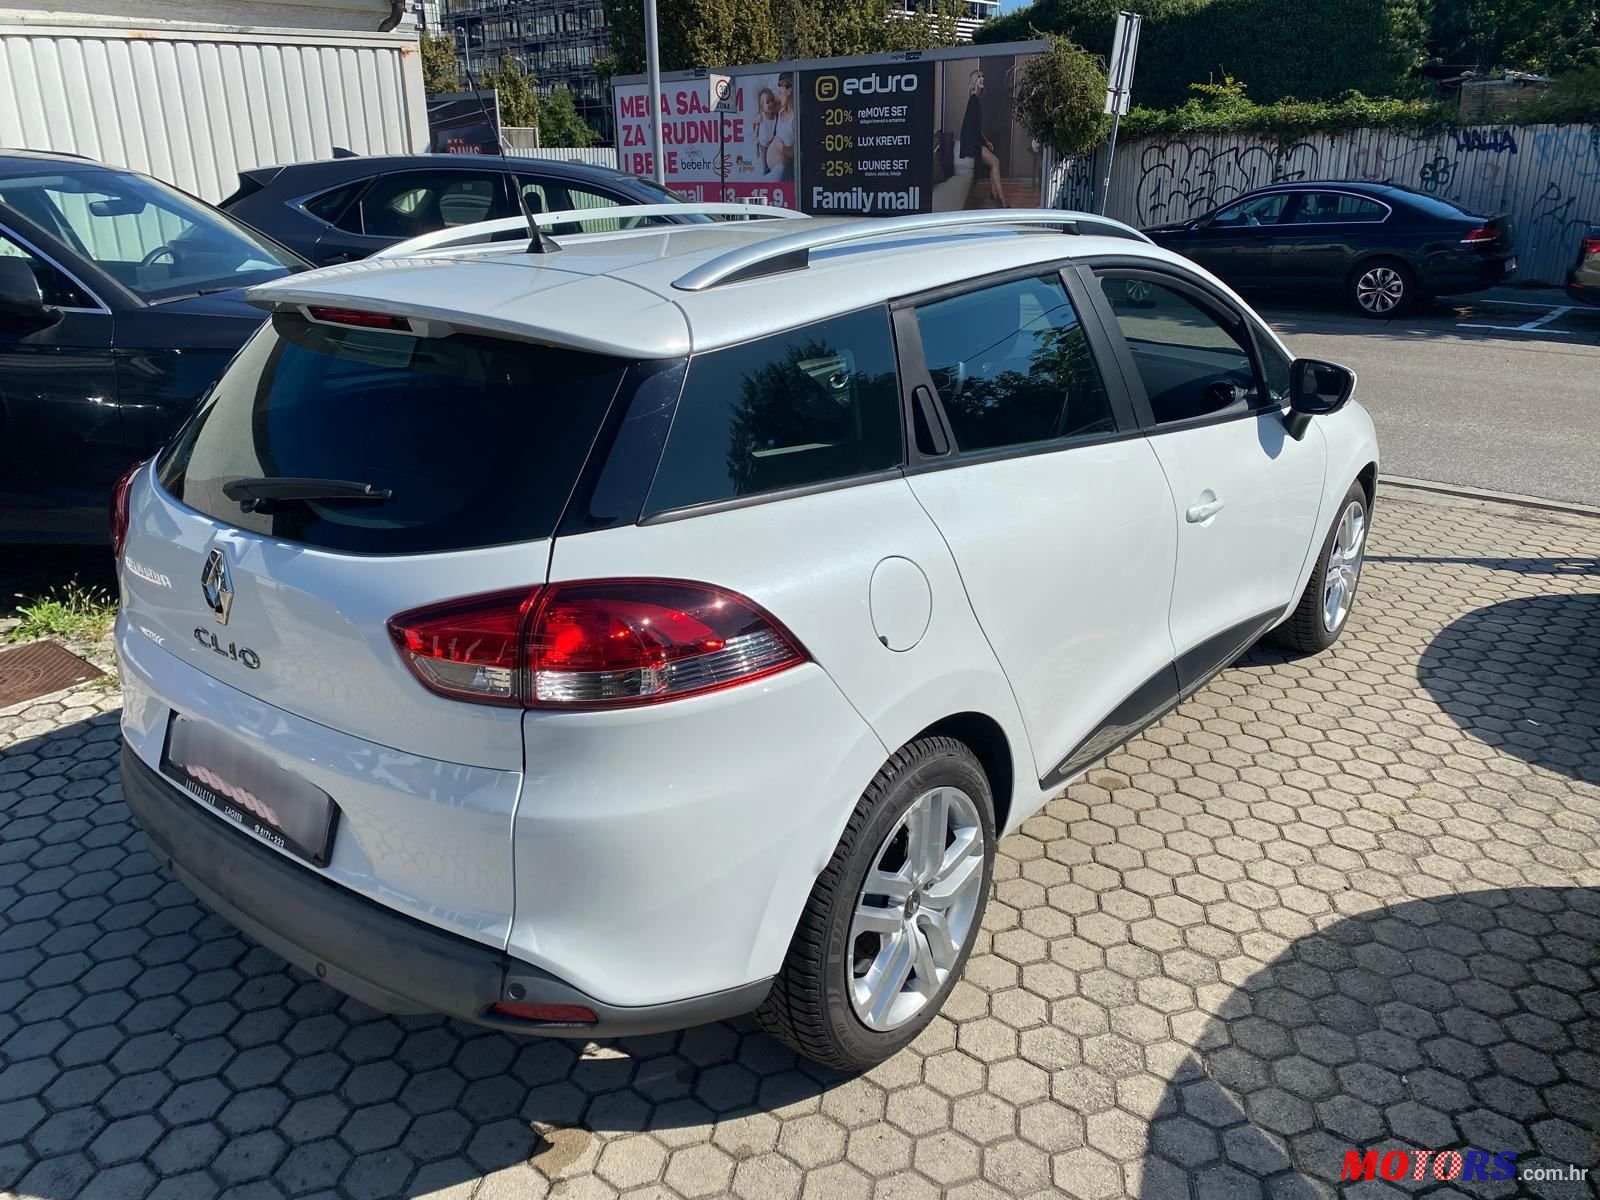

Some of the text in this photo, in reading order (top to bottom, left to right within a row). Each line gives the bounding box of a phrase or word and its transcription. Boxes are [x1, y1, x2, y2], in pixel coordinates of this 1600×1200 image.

[719, 84, 728, 96] 30
[843, 72, 918, 95] eduro
[716, 102, 730, 110] ZONA
[820, 108, 853, 126] -20%
[857, 106, 890, 118] reMOVE
[891, 105, 908, 117] SET
[622, 119, 744, 147] ZA RUDNICE
[820, 134, 911, 151] -60% LUX KREVETI
[633, 151, 679, 175] BEE
[857, 160, 891, 171] LOUNGE
[892, 159, 909, 170] SET
[812, 186, 919, 213] Family mall
[194, 625, 260, 670] CLIO
